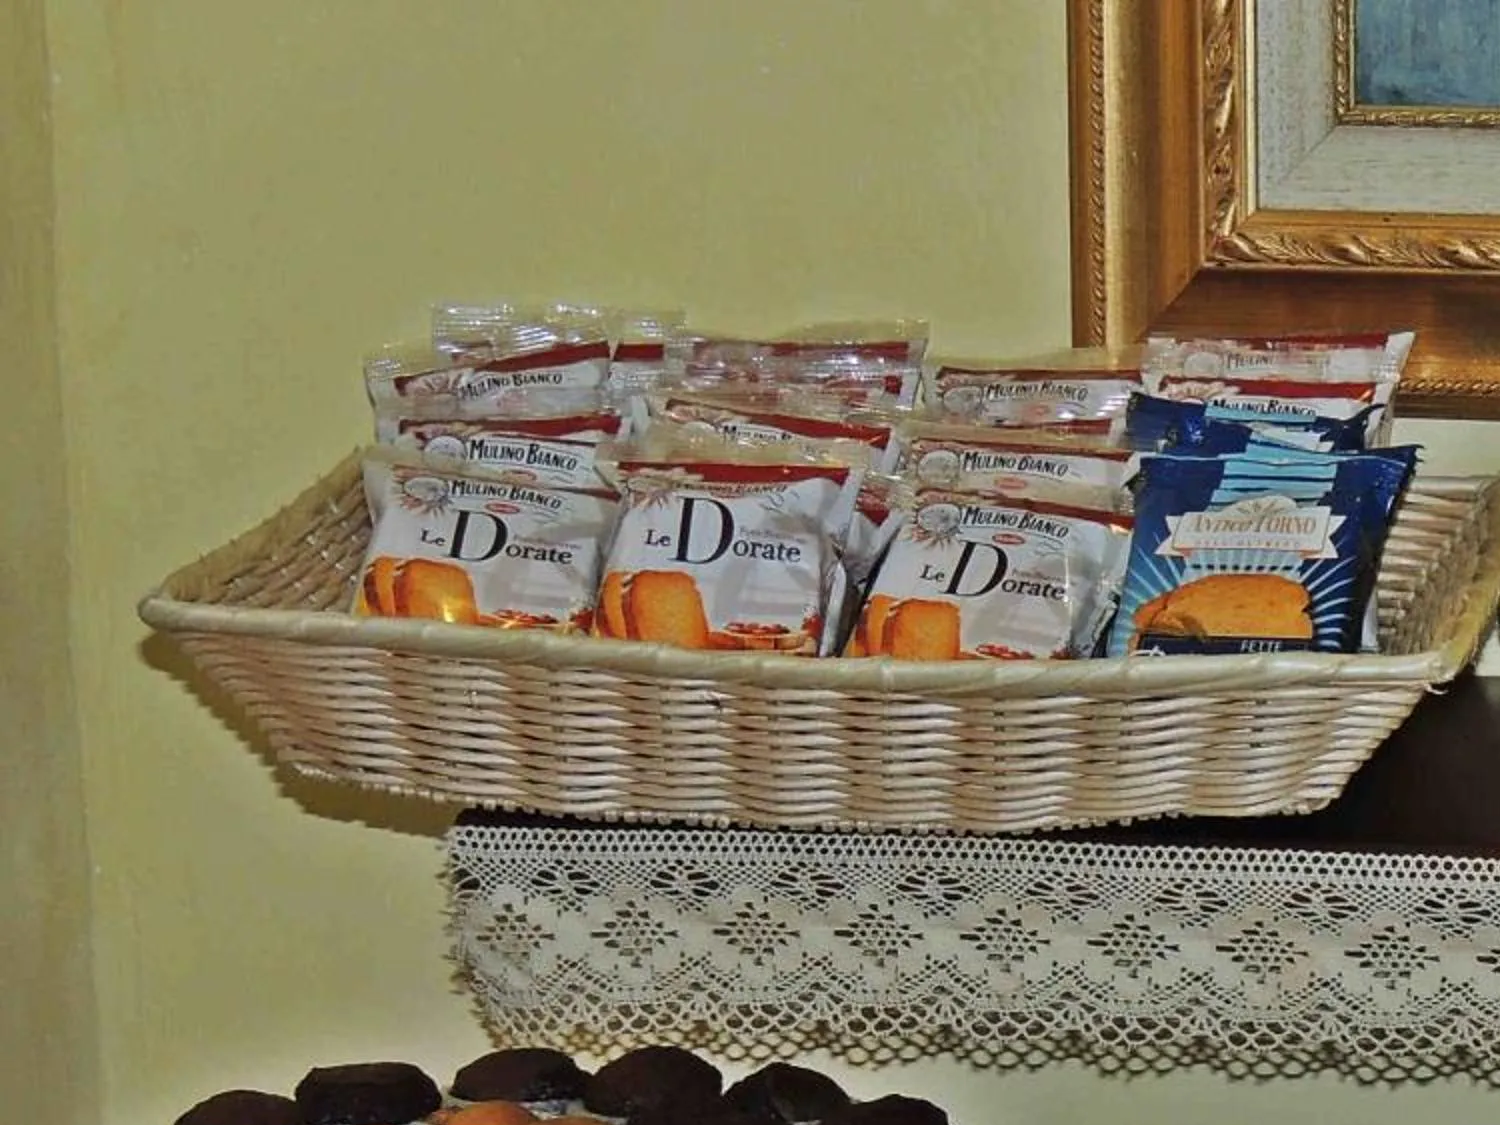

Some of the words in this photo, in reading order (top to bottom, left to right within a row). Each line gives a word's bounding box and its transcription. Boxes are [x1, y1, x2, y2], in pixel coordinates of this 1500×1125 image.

[511, 371, 563, 387] BIANCO
[986, 383, 1038, 400] MULINO
[1039, 381, 1089, 401] BIANCO
[469, 439, 525, 461] MULINO
[525, 443, 578, 471] BIANCO
[963, 451, 1017, 471] MULINO
[1017, 455, 1070, 477] BIANCO
[451, 479, 508, 498] MULINO
[509, 487, 562, 510] BIANCO
[420, 528, 446, 547] Le
[445, 508, 573, 565] Dorate
[645, 528, 672, 548] Le
[668, 495, 802, 565] Dorate
[962, 506, 1019, 526] MULINO
[1017, 512, 1070, 539] BIANCO
[1253, 513, 1317, 534] FORNO
[920, 564, 946, 583] Le
[939, 539, 1067, 601] Dorate
